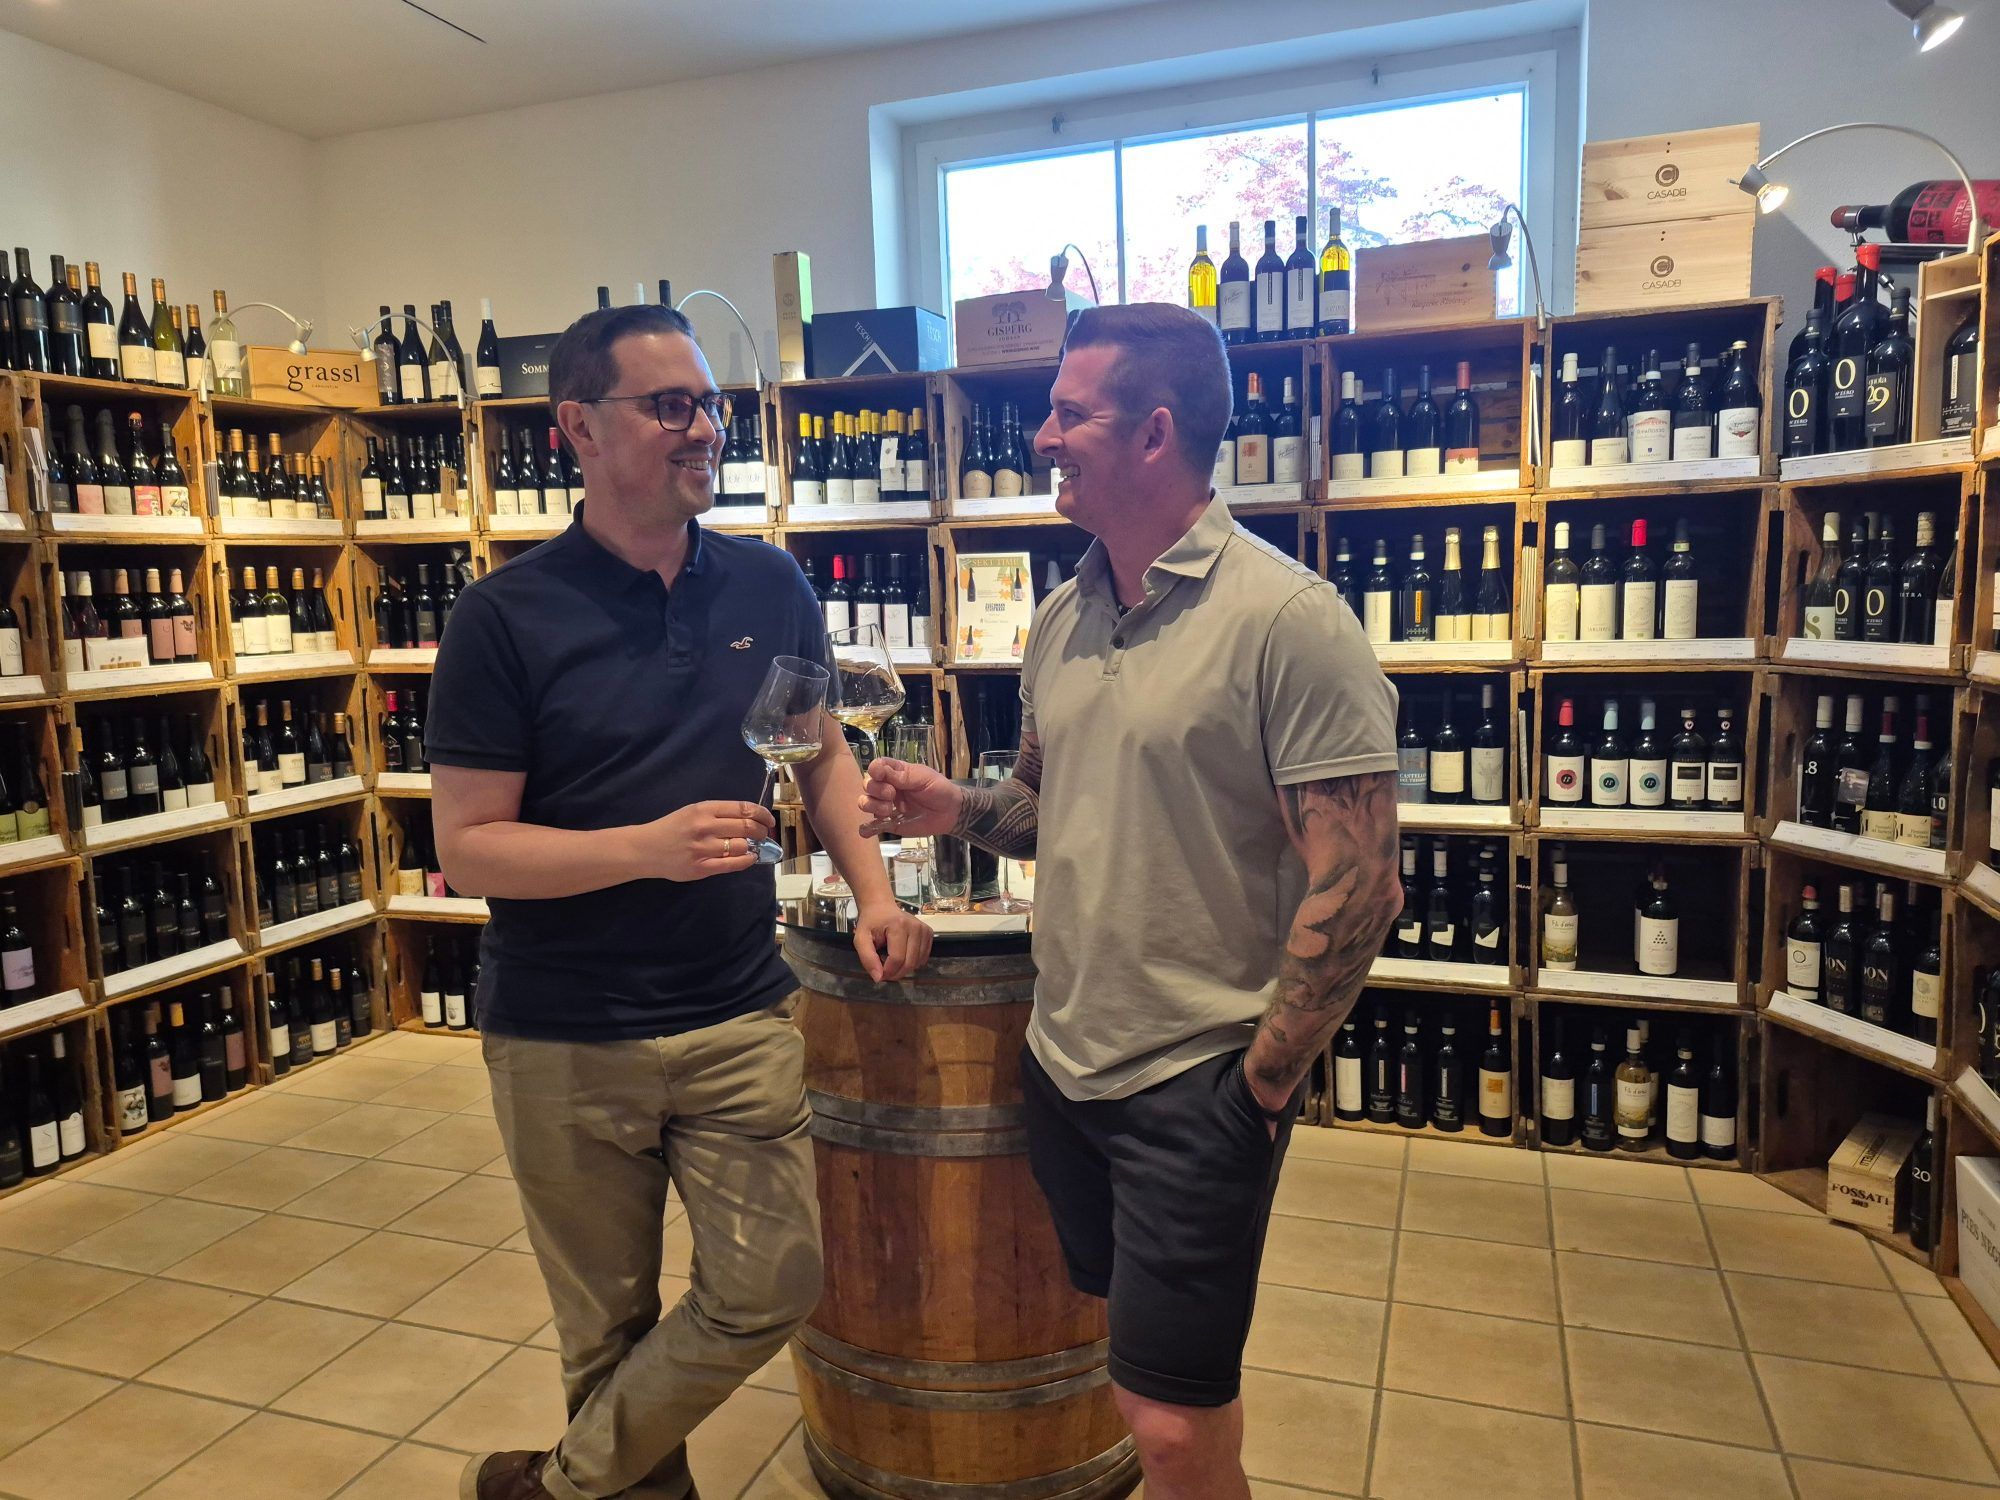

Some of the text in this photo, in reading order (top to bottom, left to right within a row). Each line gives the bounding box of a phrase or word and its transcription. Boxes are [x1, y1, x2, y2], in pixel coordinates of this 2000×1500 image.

[1647, 188, 1687, 200] CASADEI
[1641, 279, 1682, 290] CASADEI
[854, 321, 871, 342] TESCH
[286, 364, 361, 392] grassl
[1867, 386, 1890, 414] 29
[1831, 1183, 1889, 1206] FOSSATI
